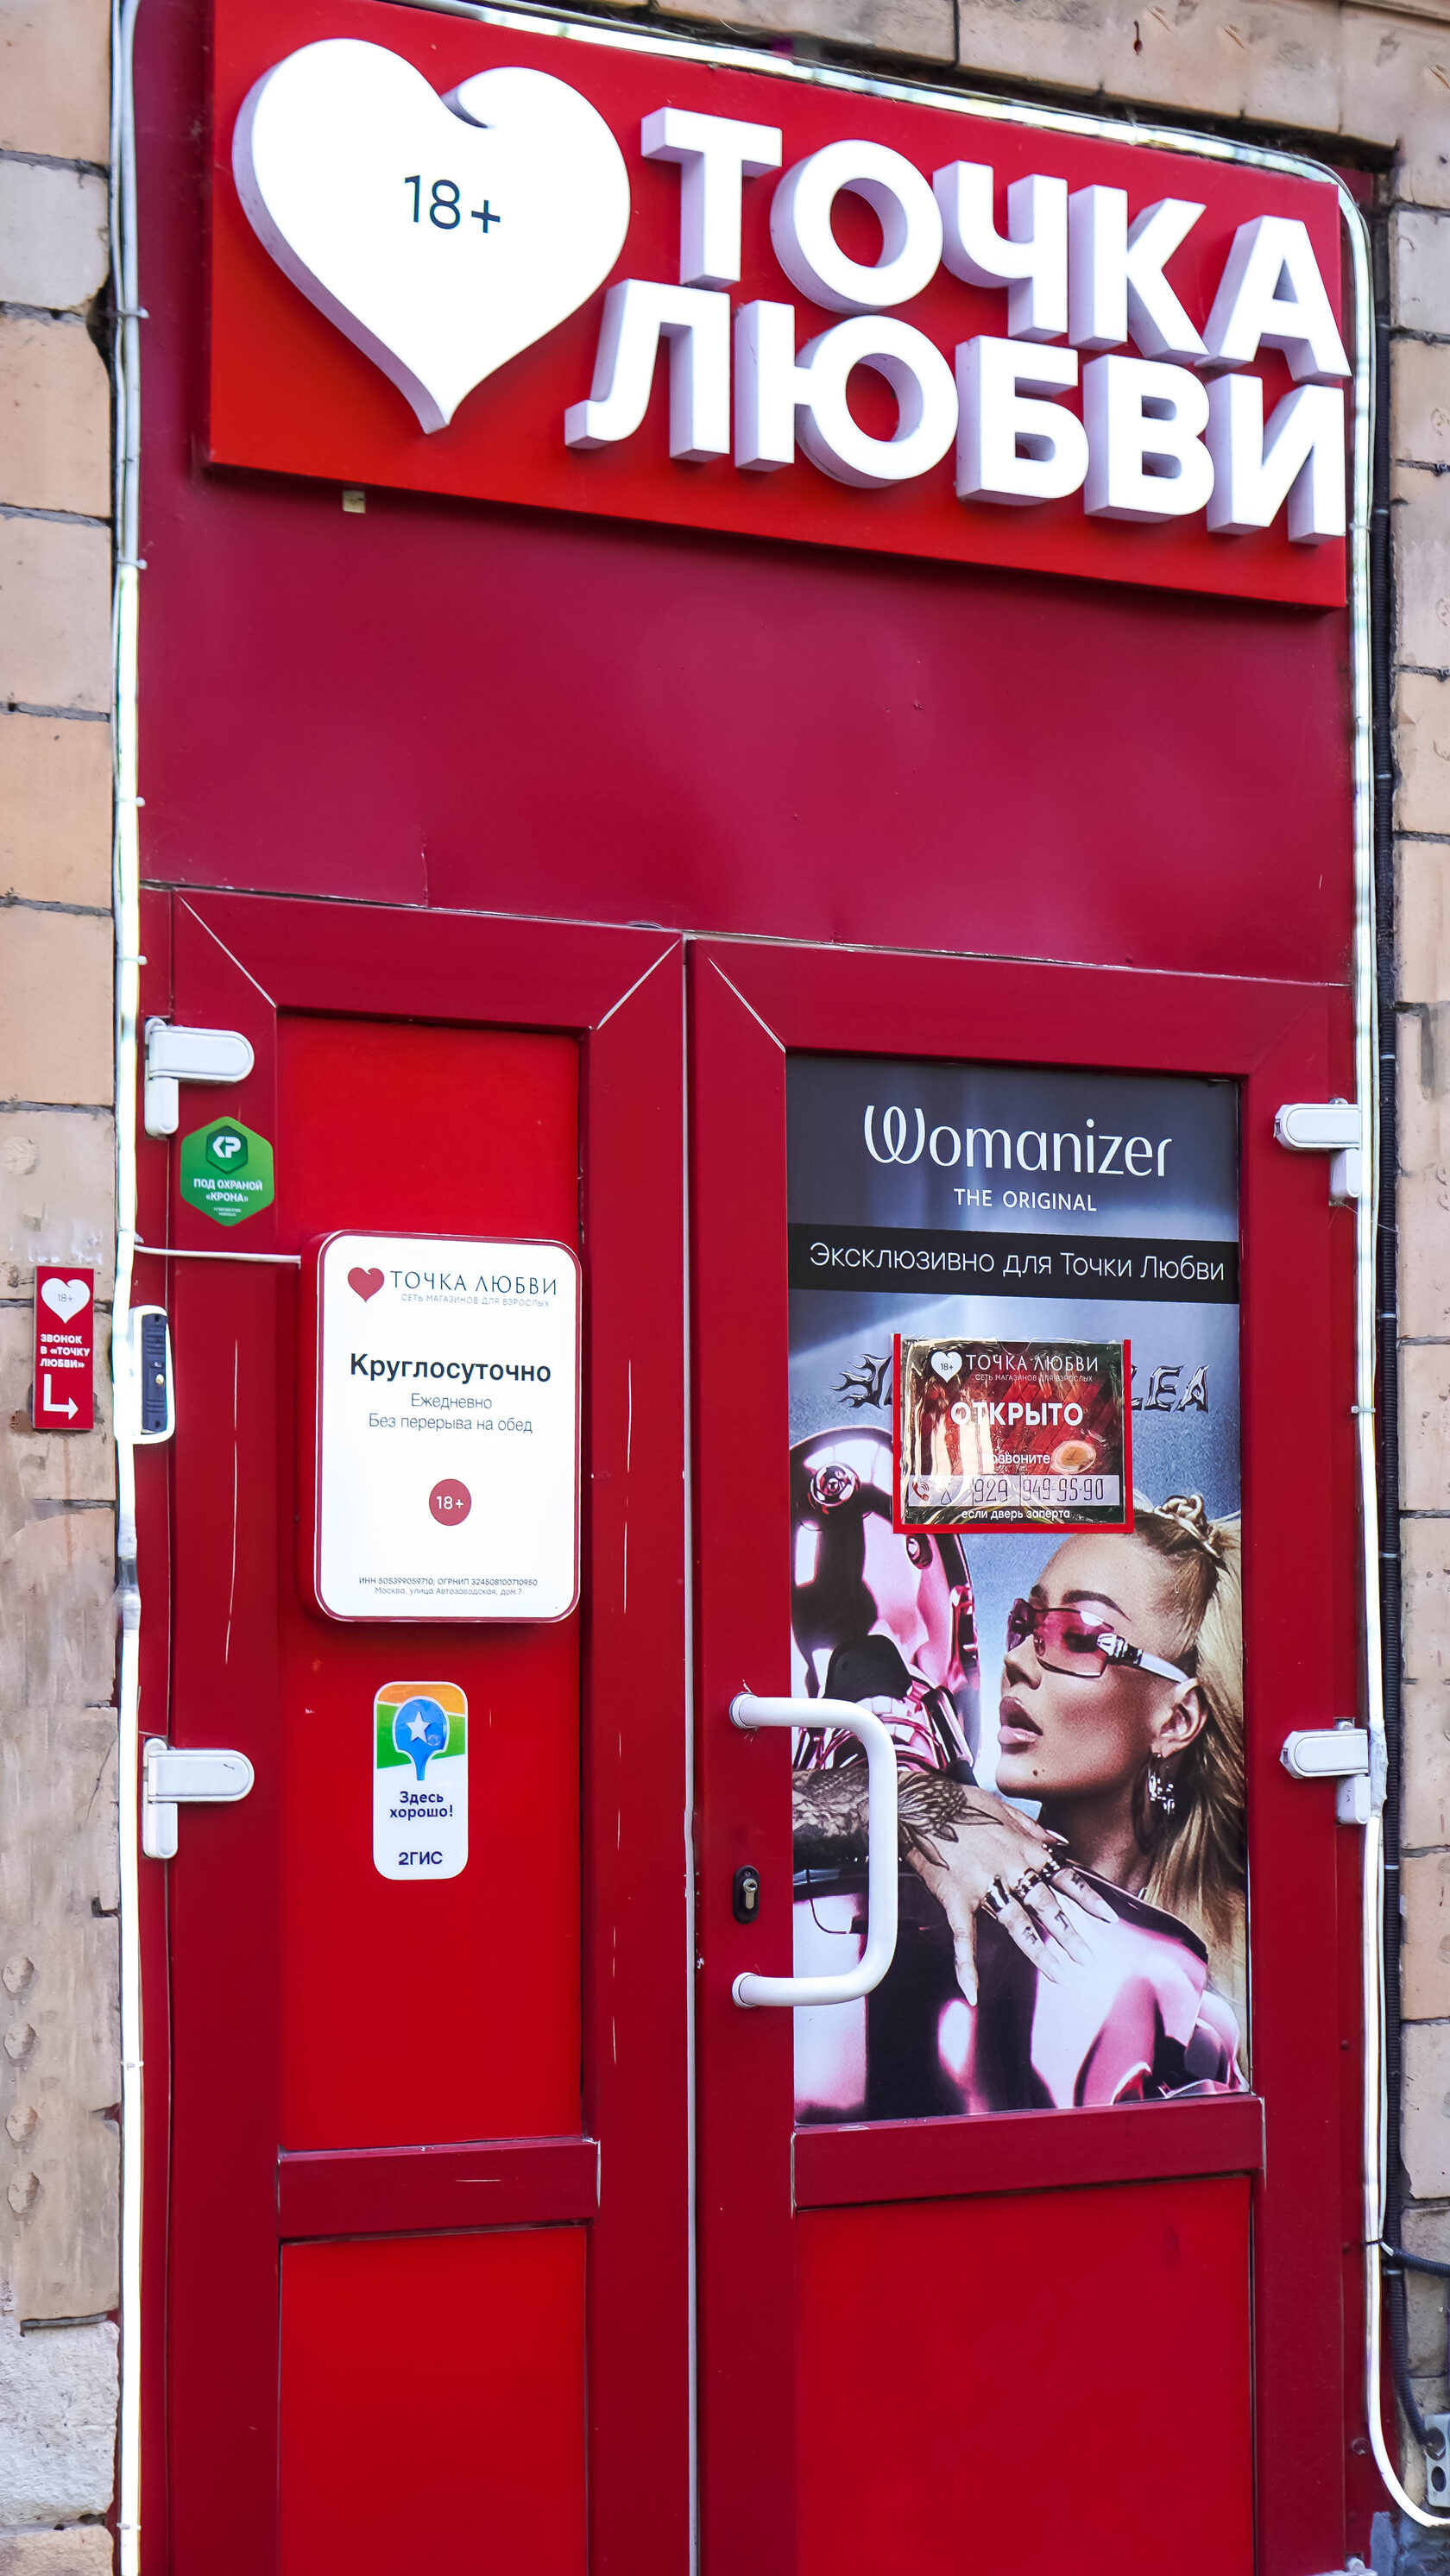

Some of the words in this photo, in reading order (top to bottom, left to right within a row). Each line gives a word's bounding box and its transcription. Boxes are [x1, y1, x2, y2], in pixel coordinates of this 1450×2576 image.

[403, 174, 501, 235] 18+
[641, 107, 1352, 384] ТОЧКА
[564, 279, 1346, 545] ЛЮБВИ
[863, 1105, 1173, 1177] Womanizer
[193, 1178, 216, 1190] ПОД
[217, 1179, 262, 1191] ОХРАНОЙ
[205, 1192, 249, 1202] «КРОНА»
[954, 1188, 993, 1206] THE
[1002, 1190, 1097, 1212] ORIGINAL
[810, 1243, 994, 1273] Эксклюзивно
[1003, 1254, 1052, 1276] для
[1060, 1252, 1132, 1277] Точки
[1140, 1256, 1225, 1282] Любви
[390, 1271, 467, 1291] ТОЧКА
[475, 1275, 556, 1295] ЛЮБВИ
[58, 1294, 72, 1302] 18+
[401, 1293, 424, 1302] СЕТЬ
[426, 1294, 479, 1305] МАГАЗИНОВ
[482, 1297, 500, 1306] ДЛЯ
[502, 1298, 550, 1307] ВЗРОСЛЫХ
[41, 1333, 83, 1345] ЗВОНОК
[40, 1345, 47, 1355] В
[50, 1346, 91, 1357] «ТОЧКУ
[40, 1357, 85, 1368] ЛЮБВИ»
[350, 1352, 552, 1384] Круглосуточно
[940, 1363, 954, 1371] 18+
[966, 1354, 1028, 1371] ТОЧКА
[1034, 1355, 1099, 1372] ЛЮБВИ
[411, 1393, 492, 1410] Ежедневно
[950, 1401, 1083, 1427] ОТКРЫТО
[369, 1413, 396, 1427] Без
[400, 1417, 472, 1432] перерыва
[476, 1420, 494, 1431] на
[497, 1417, 533, 1434] обед
[974, 1478, 1008, 1502] 929
[436, 1496, 464, 1510] 18+
[961, 1509, 988, 1519] если
[991, 1509, 1024, 1521] дверь
[1027, 1510, 1070, 1520] заперта
[437, 1578, 469, 1586] ОГРНИП
[409, 1588, 434, 1597] улица
[400, 1791, 444, 1805] Здесь
[390, 1804, 453, 1821] хорошо!
[398, 1851, 443, 1866] 2ГИС
